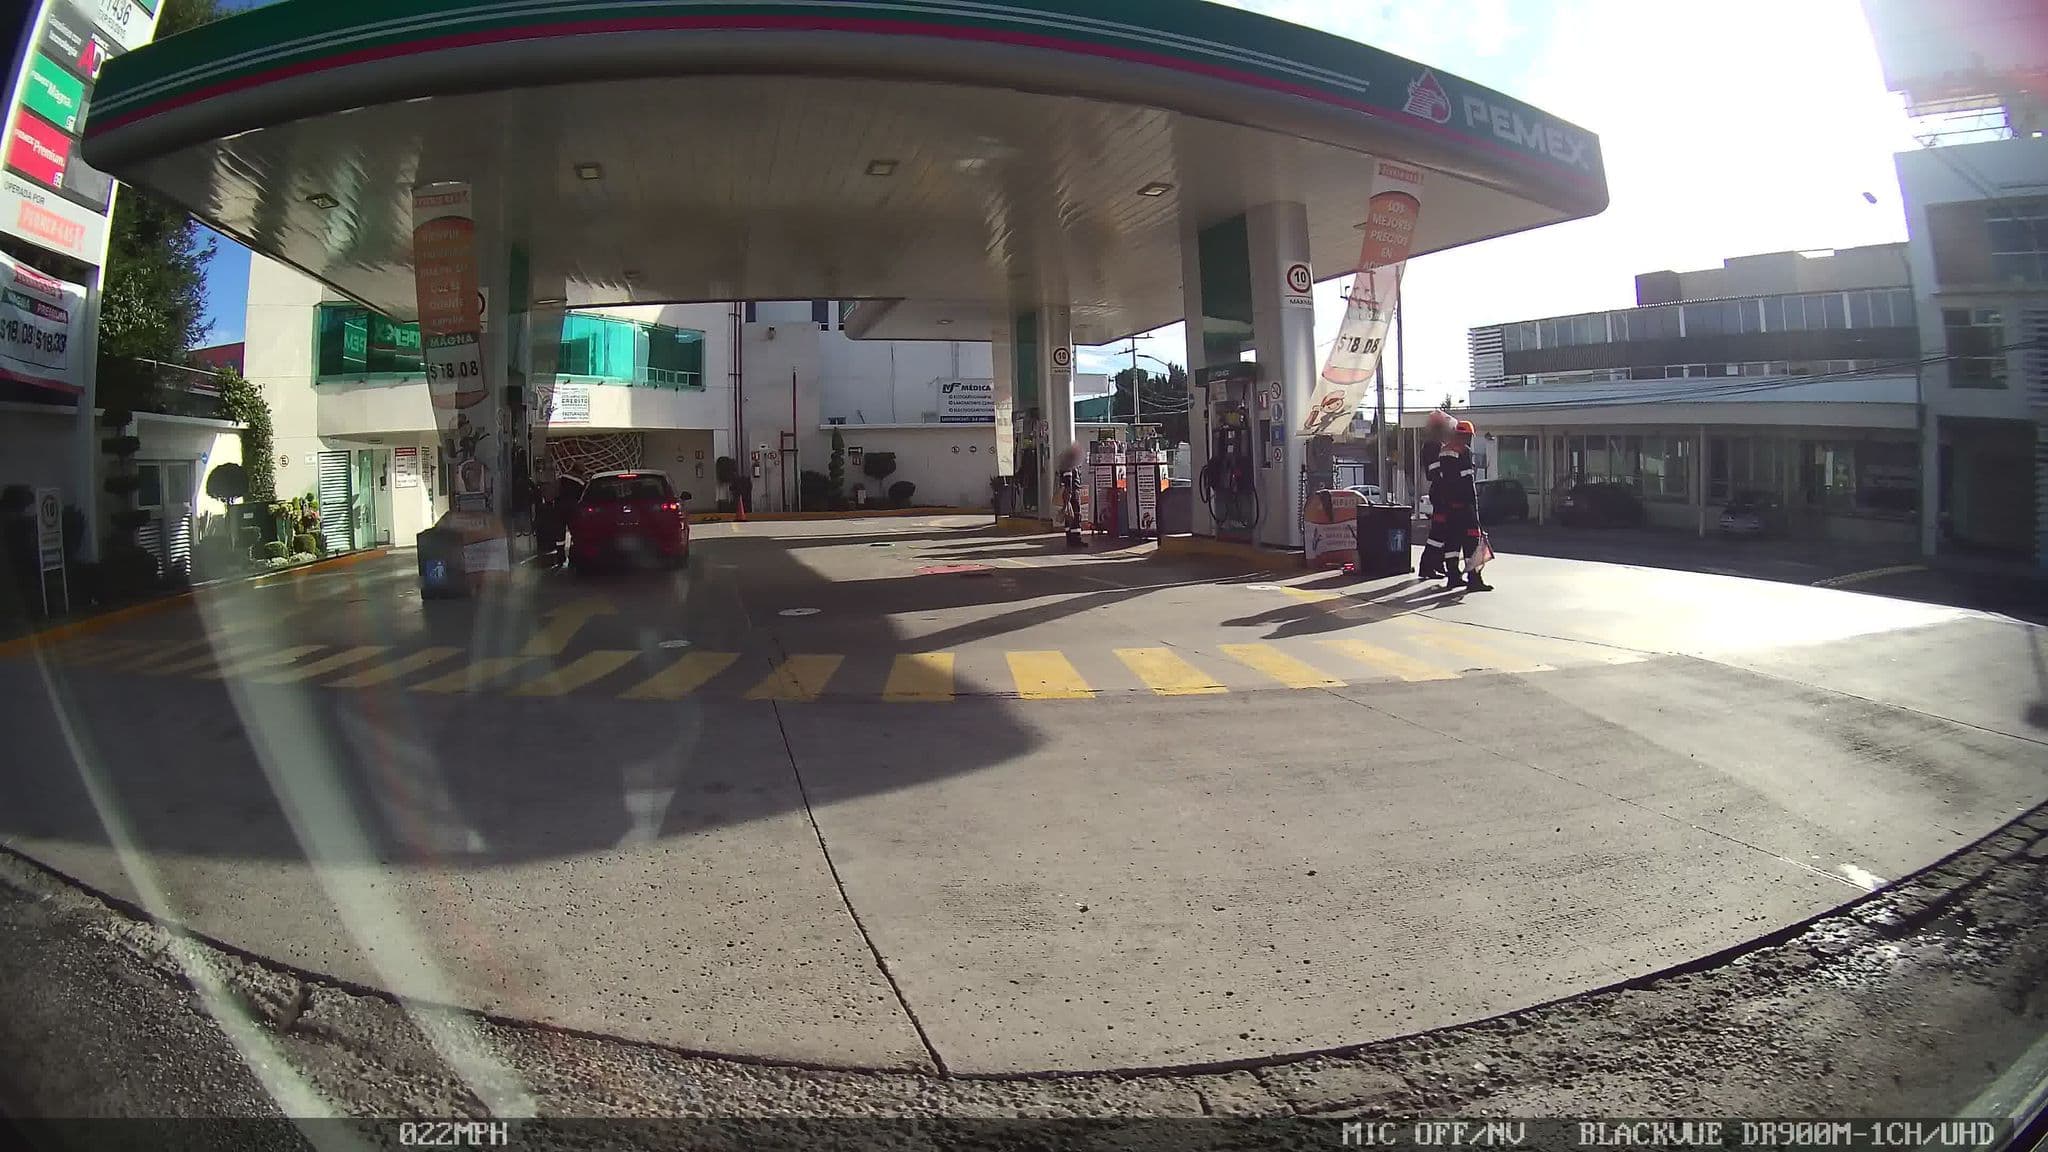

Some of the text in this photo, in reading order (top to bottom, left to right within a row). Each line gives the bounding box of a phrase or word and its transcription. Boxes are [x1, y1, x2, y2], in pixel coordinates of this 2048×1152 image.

[1463, 95, 1592, 170] PEMEX
[32, 140, 65, 167] Premium
[4, 180, 45, 205] OPERADA POR
[1294, 271, 1306, 283] 10
[430, 333, 474, 348] MAGNA
